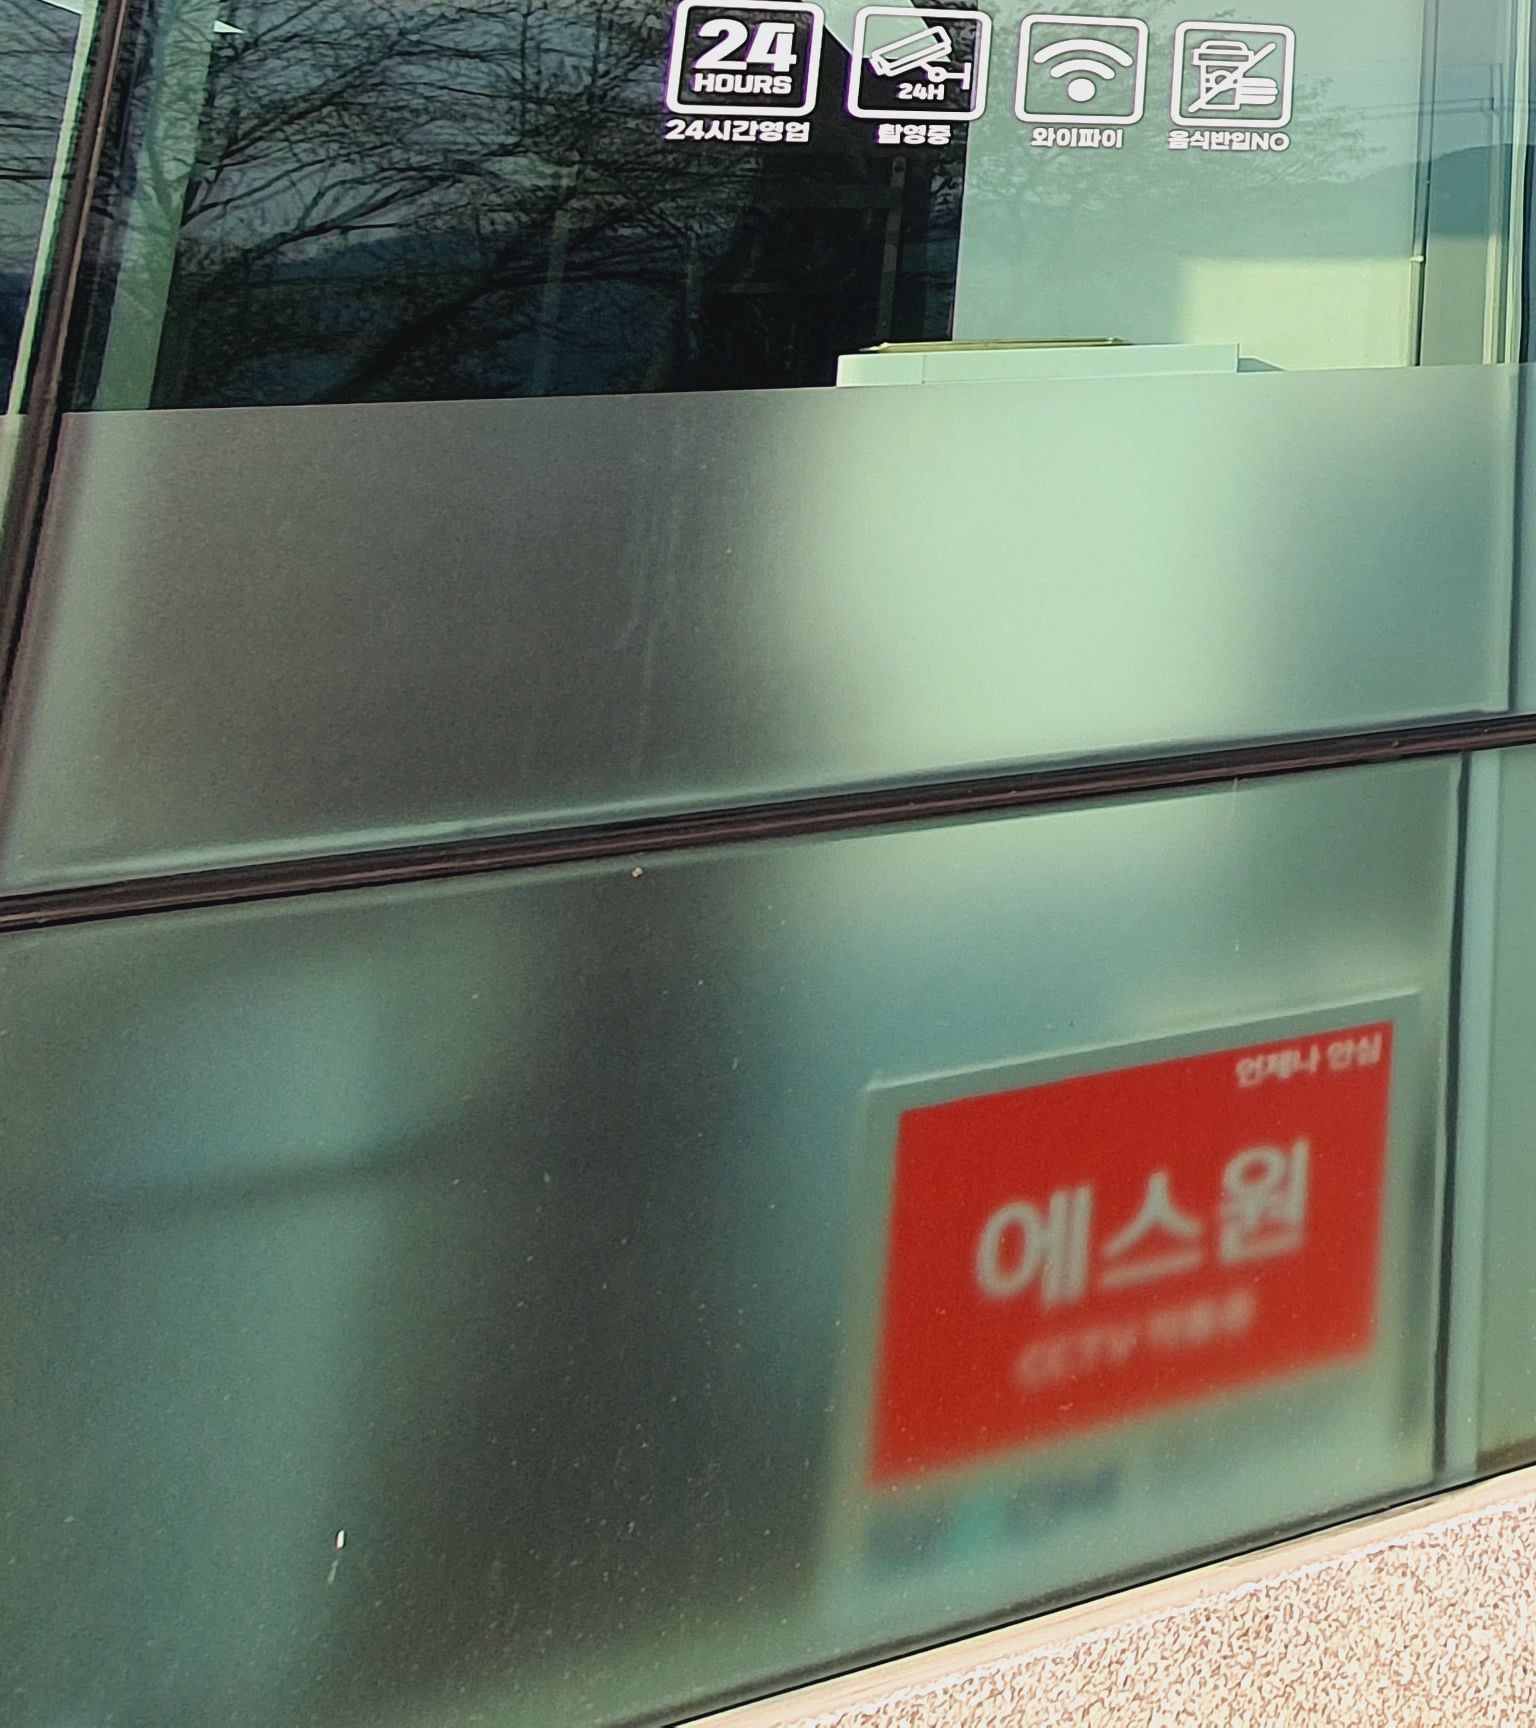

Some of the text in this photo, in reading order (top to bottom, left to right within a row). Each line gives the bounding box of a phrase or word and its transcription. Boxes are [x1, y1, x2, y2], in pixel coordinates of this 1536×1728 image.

[695, 18, 797, 72] 24
[694, 73, 793, 95] HOURS
[898, 83, 945, 101] 24H
[663, 120, 810, 143] 24시간영업
[1031, 127, 1123, 149] 와이파이
[1167, 130, 1290, 152] 음식반입NO
[974, 1135, 1311, 1311] 에스원
